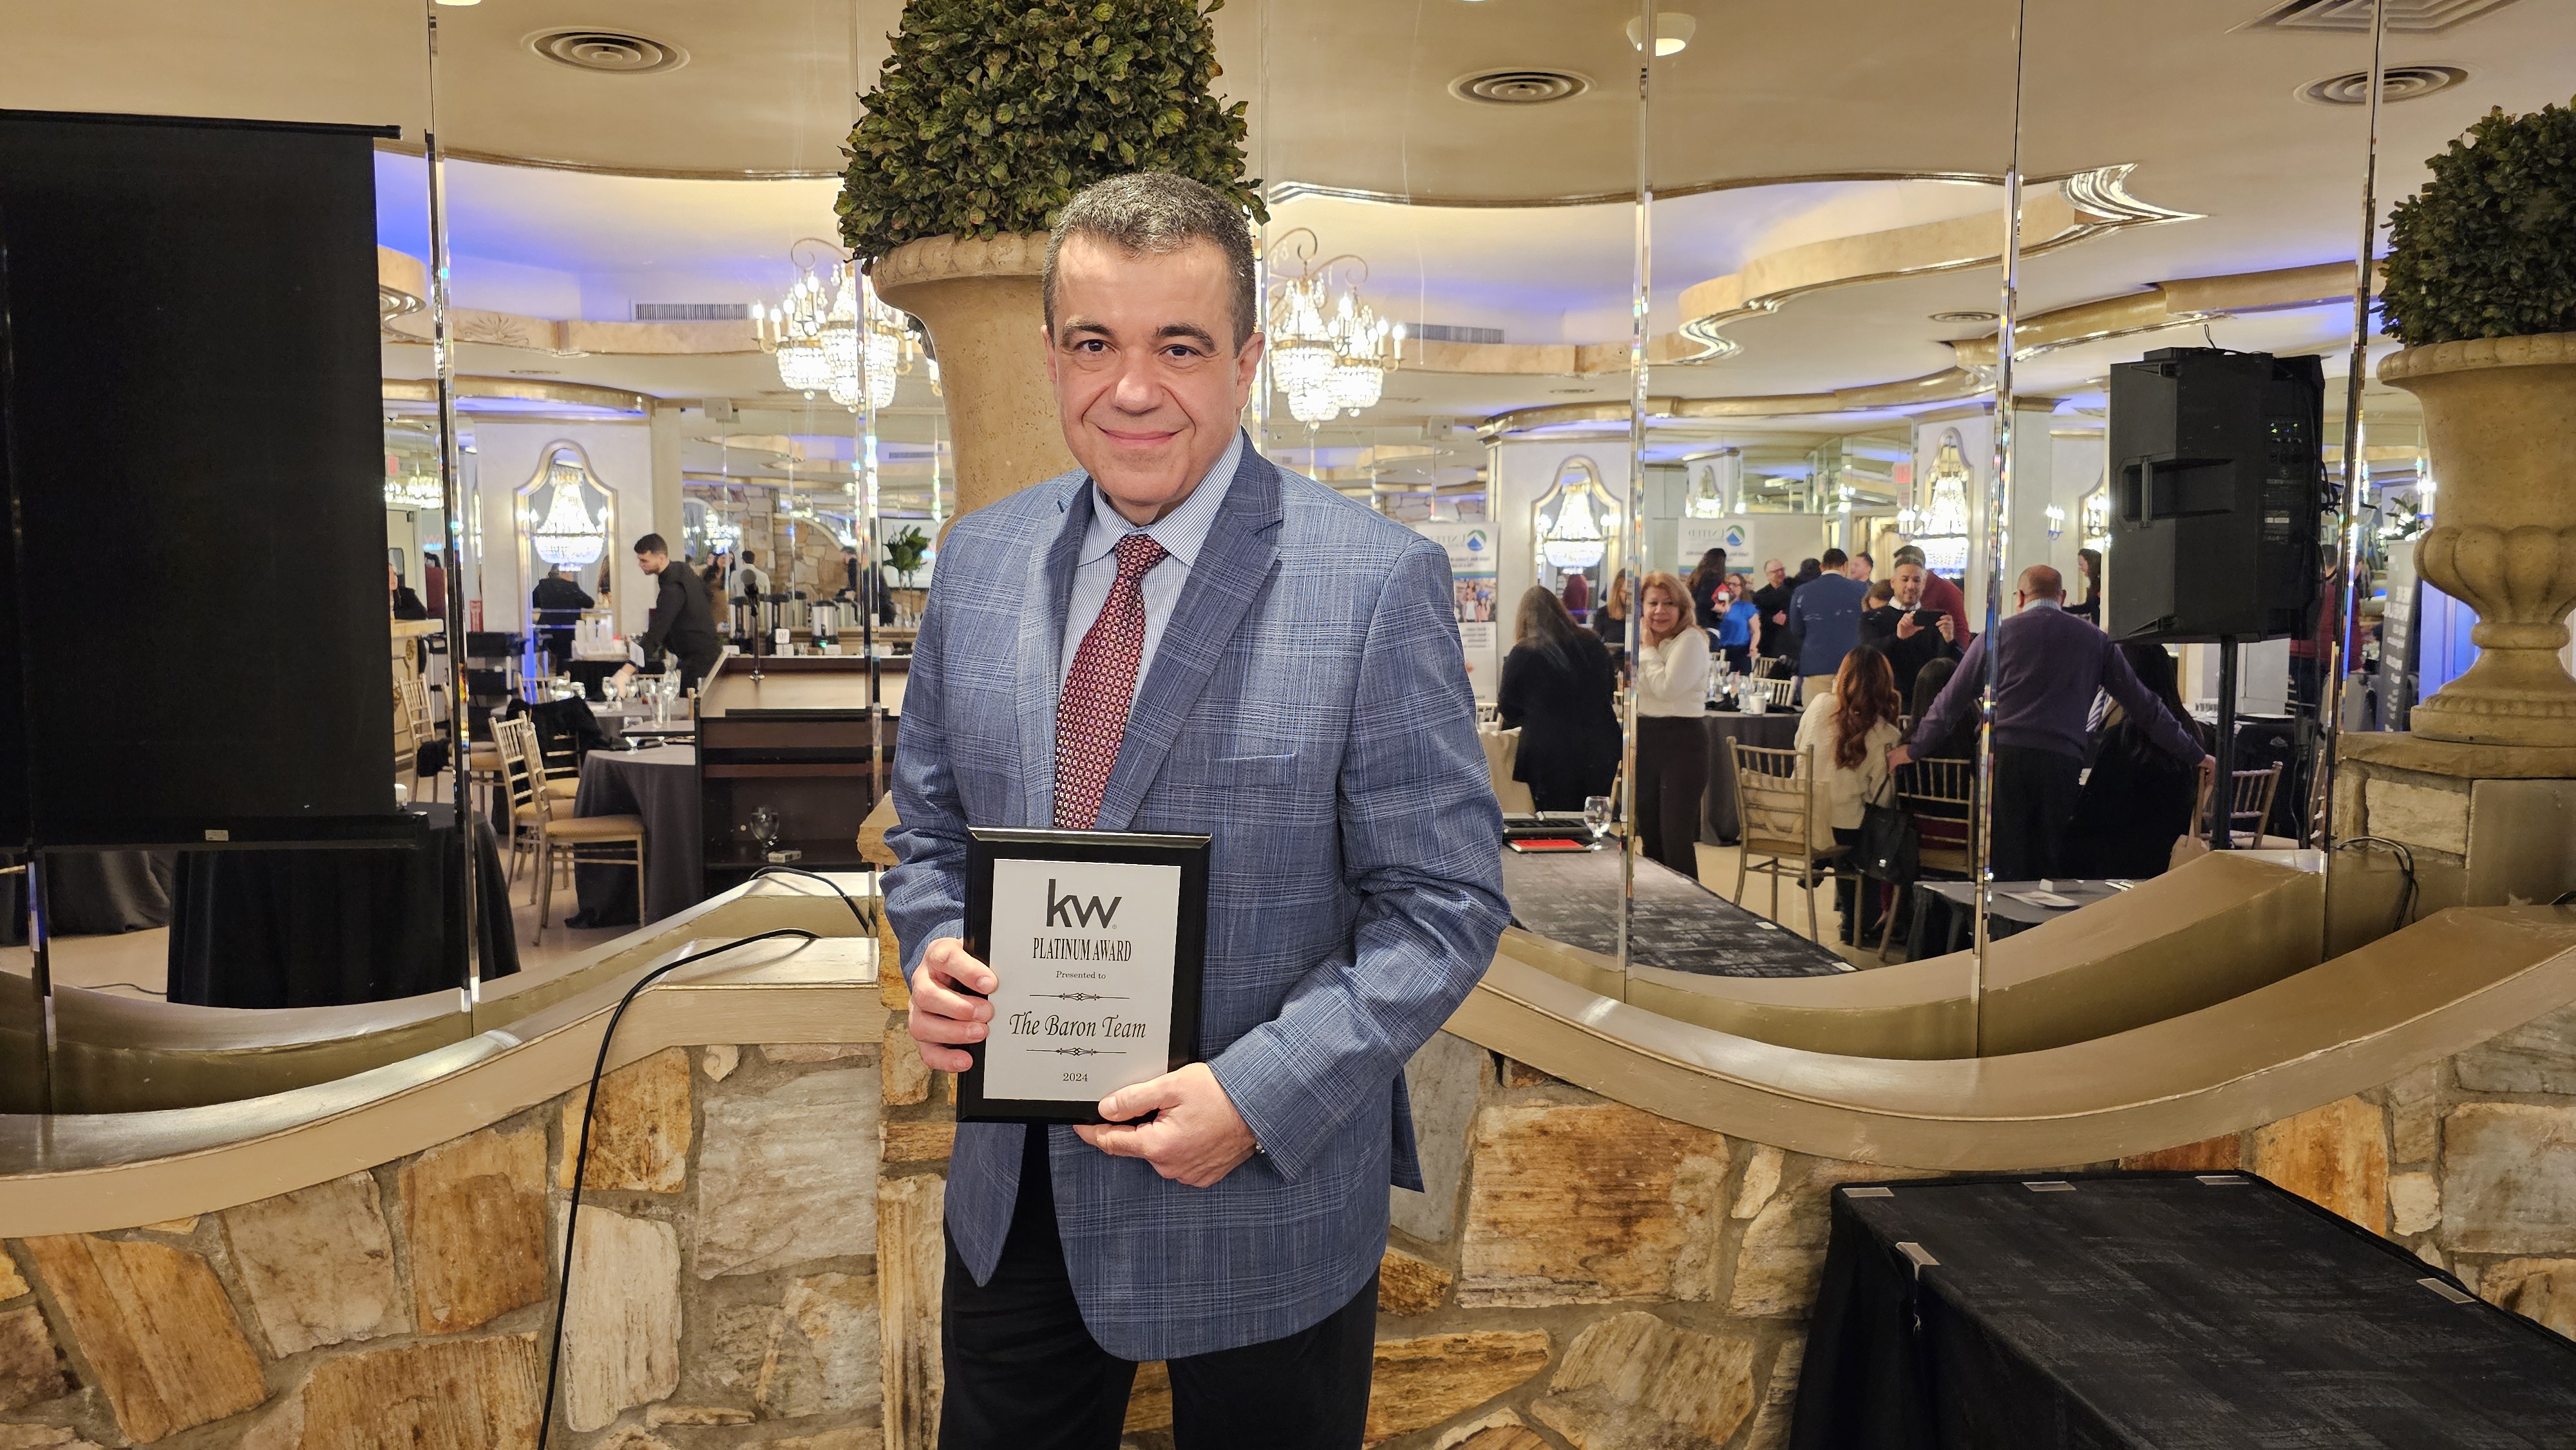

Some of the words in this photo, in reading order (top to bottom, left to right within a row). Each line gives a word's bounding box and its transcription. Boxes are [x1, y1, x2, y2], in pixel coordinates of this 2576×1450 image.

[1032, 937, 1090, 961] PLATINUM
[1092, 939, 1132, 961] AWARD
[1056, 970, 1096, 980] Presented
[1009, 1010, 1039, 1037] The
[1044, 1014, 1097, 1038] Baron
[1102, 1014, 1146, 1039] Team
[1063, 1072, 1088, 1082] 2024
